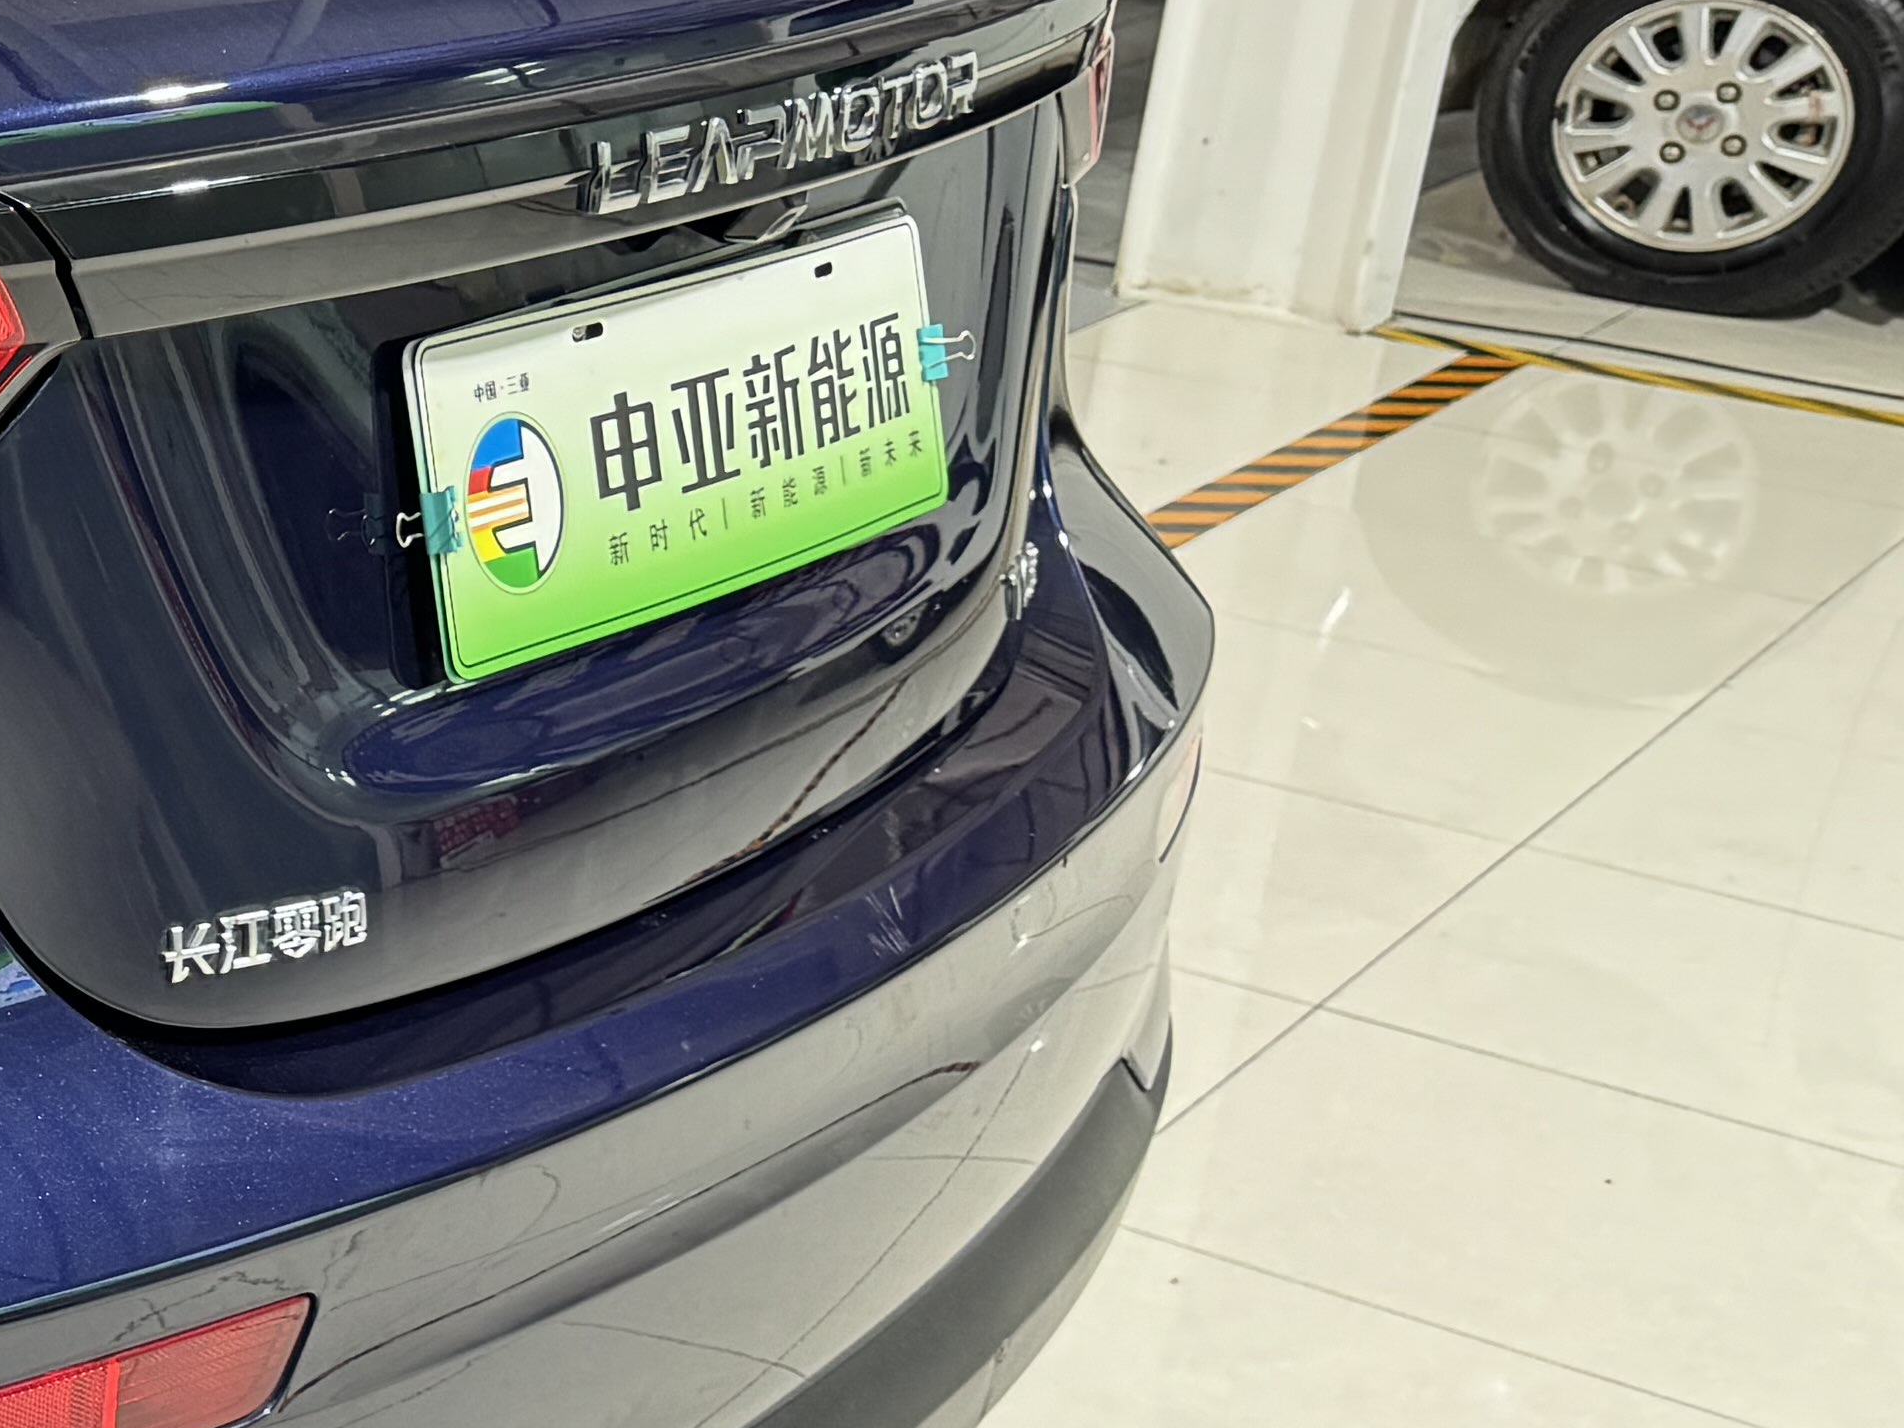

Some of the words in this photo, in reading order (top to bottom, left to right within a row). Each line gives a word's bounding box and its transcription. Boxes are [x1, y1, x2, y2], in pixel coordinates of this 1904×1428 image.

[578, 51, 978, 215] LEAPMOTOR
[590, 312, 911, 512] 申亚新能源
[160, 888, 368, 984] 长江零跑
